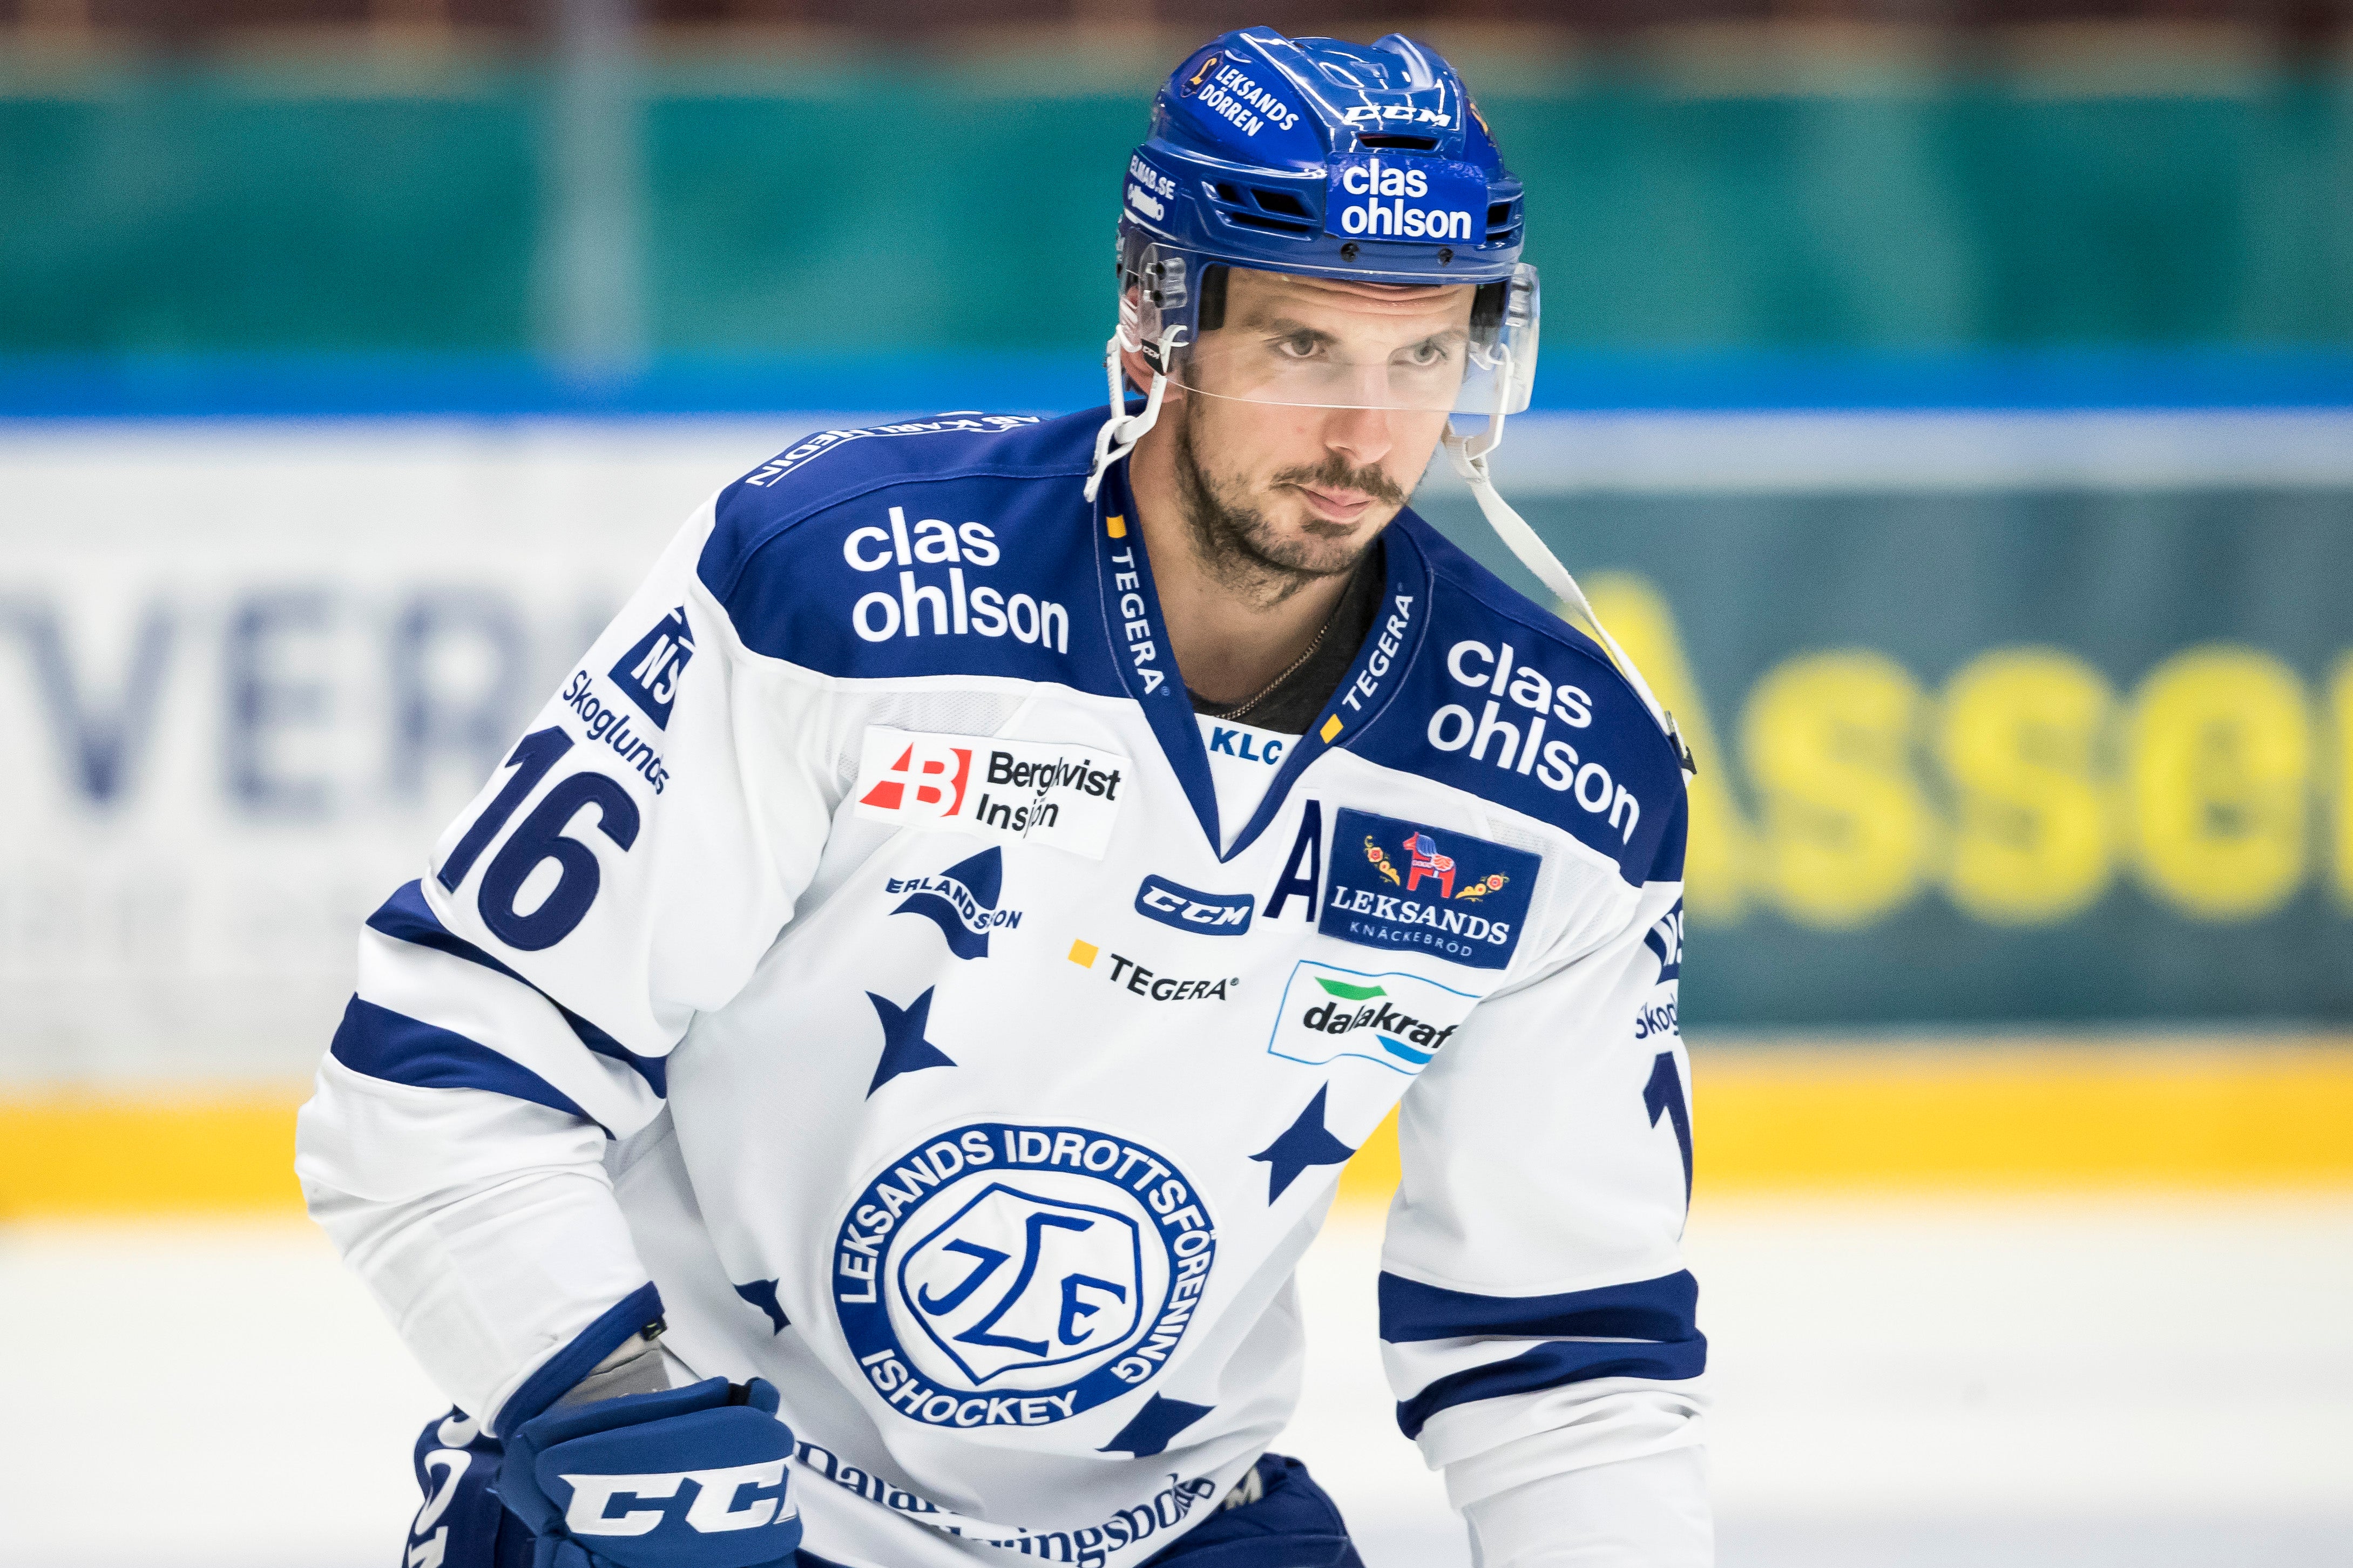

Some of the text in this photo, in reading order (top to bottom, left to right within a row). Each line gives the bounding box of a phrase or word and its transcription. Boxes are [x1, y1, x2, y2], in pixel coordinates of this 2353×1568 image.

[1198, 84, 1264, 137] DÖRREN
[1215, 65, 1299, 131] LEKSANDS
[1344, 105, 1452, 127] CCM
[1343, 158, 1428, 198] clas
[1341, 197, 1472, 239] ohlson
[843, 506, 1000, 572] clas
[853, 567, 1069, 654] ohlson
[630, 634, 680, 704] NS
[1448, 640, 1593, 729] clas
[1209, 726, 1283, 765] KLC
[1428, 701, 1640, 845] ohlson
[1571, 572, 2353, 928] Asse
[436, 725, 641, 952] 16
[1262, 799, 1321, 922] A
[885, 877, 1023, 929] ERLANDSON
[1140, 885, 1252, 926] CCM
[1331, 886, 1510, 945] LEKSANDS
[1350, 922, 1473, 956] KNÄCKEBRÖD
[840, 1130, 1217, 1383] LEKSANDS IDROTTSFÖRENING
[861, 1349, 1078, 1427] ISHOCKEY
